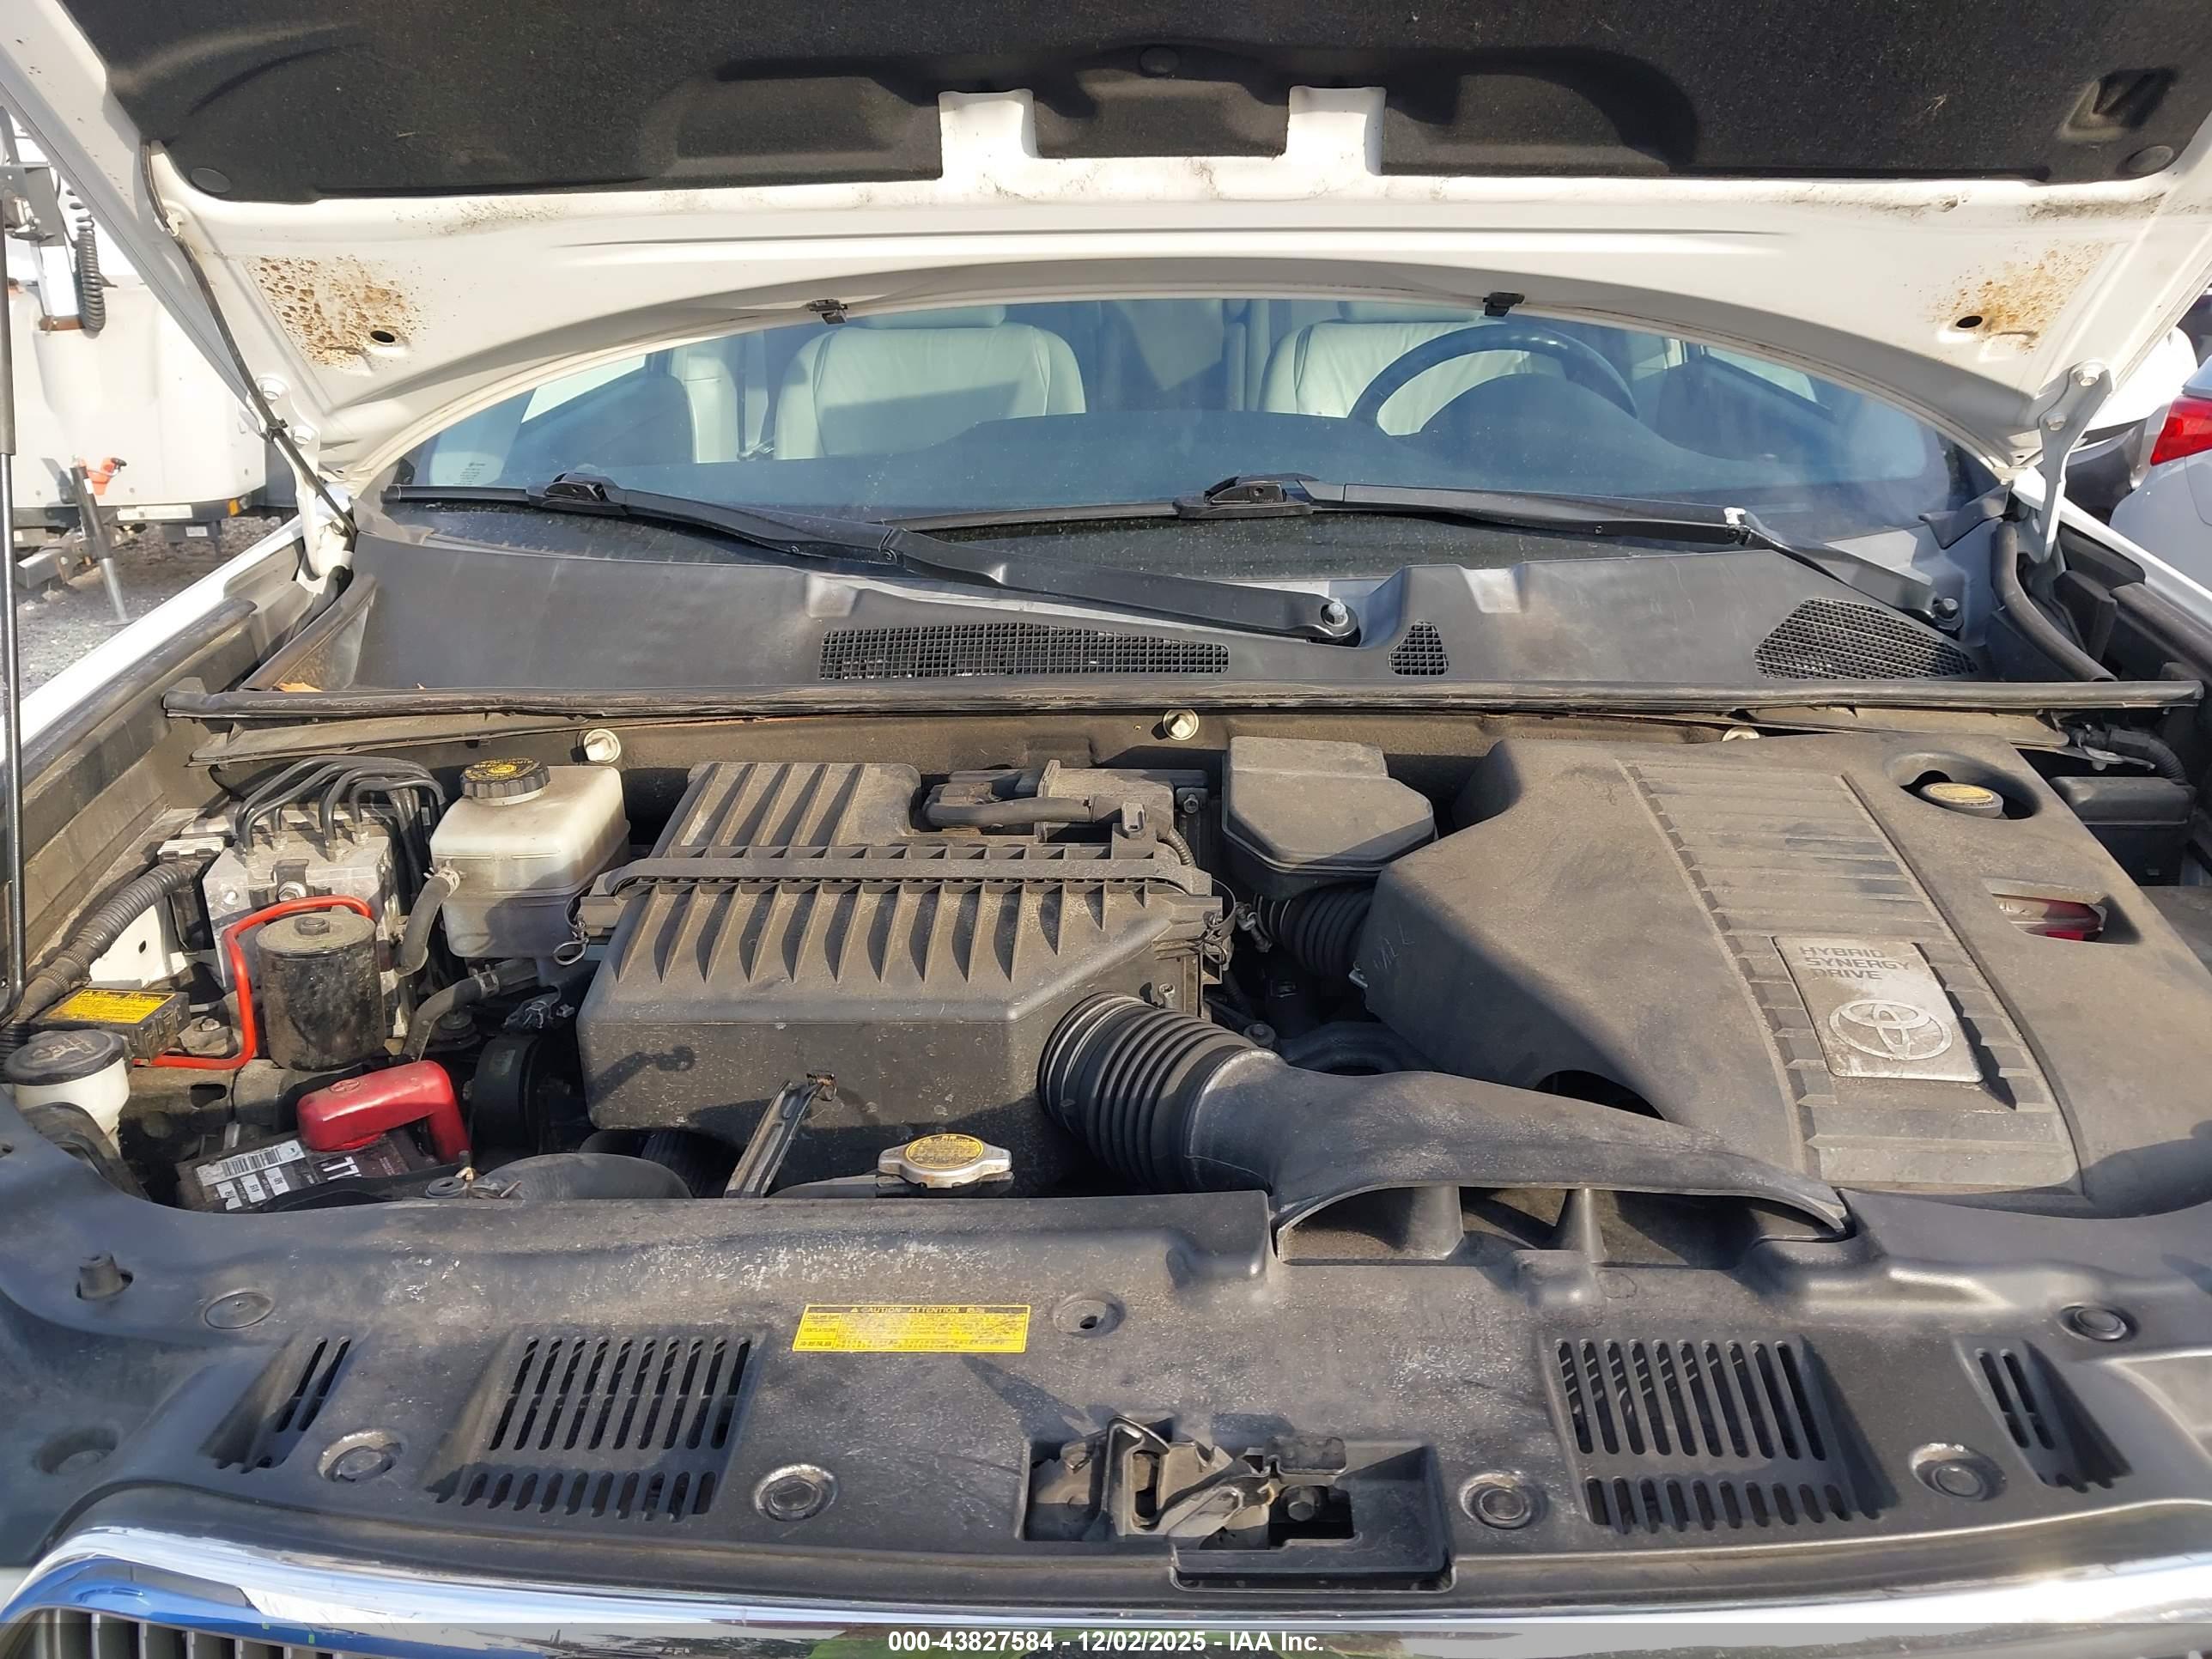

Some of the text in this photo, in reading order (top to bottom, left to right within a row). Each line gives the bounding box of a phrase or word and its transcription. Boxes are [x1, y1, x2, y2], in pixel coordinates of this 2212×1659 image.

[1799, 946, 1886, 959] HYBRID
[1804, 957, 1910, 970] SYNERGY
[1809, 967, 1883, 981] DRIVE
